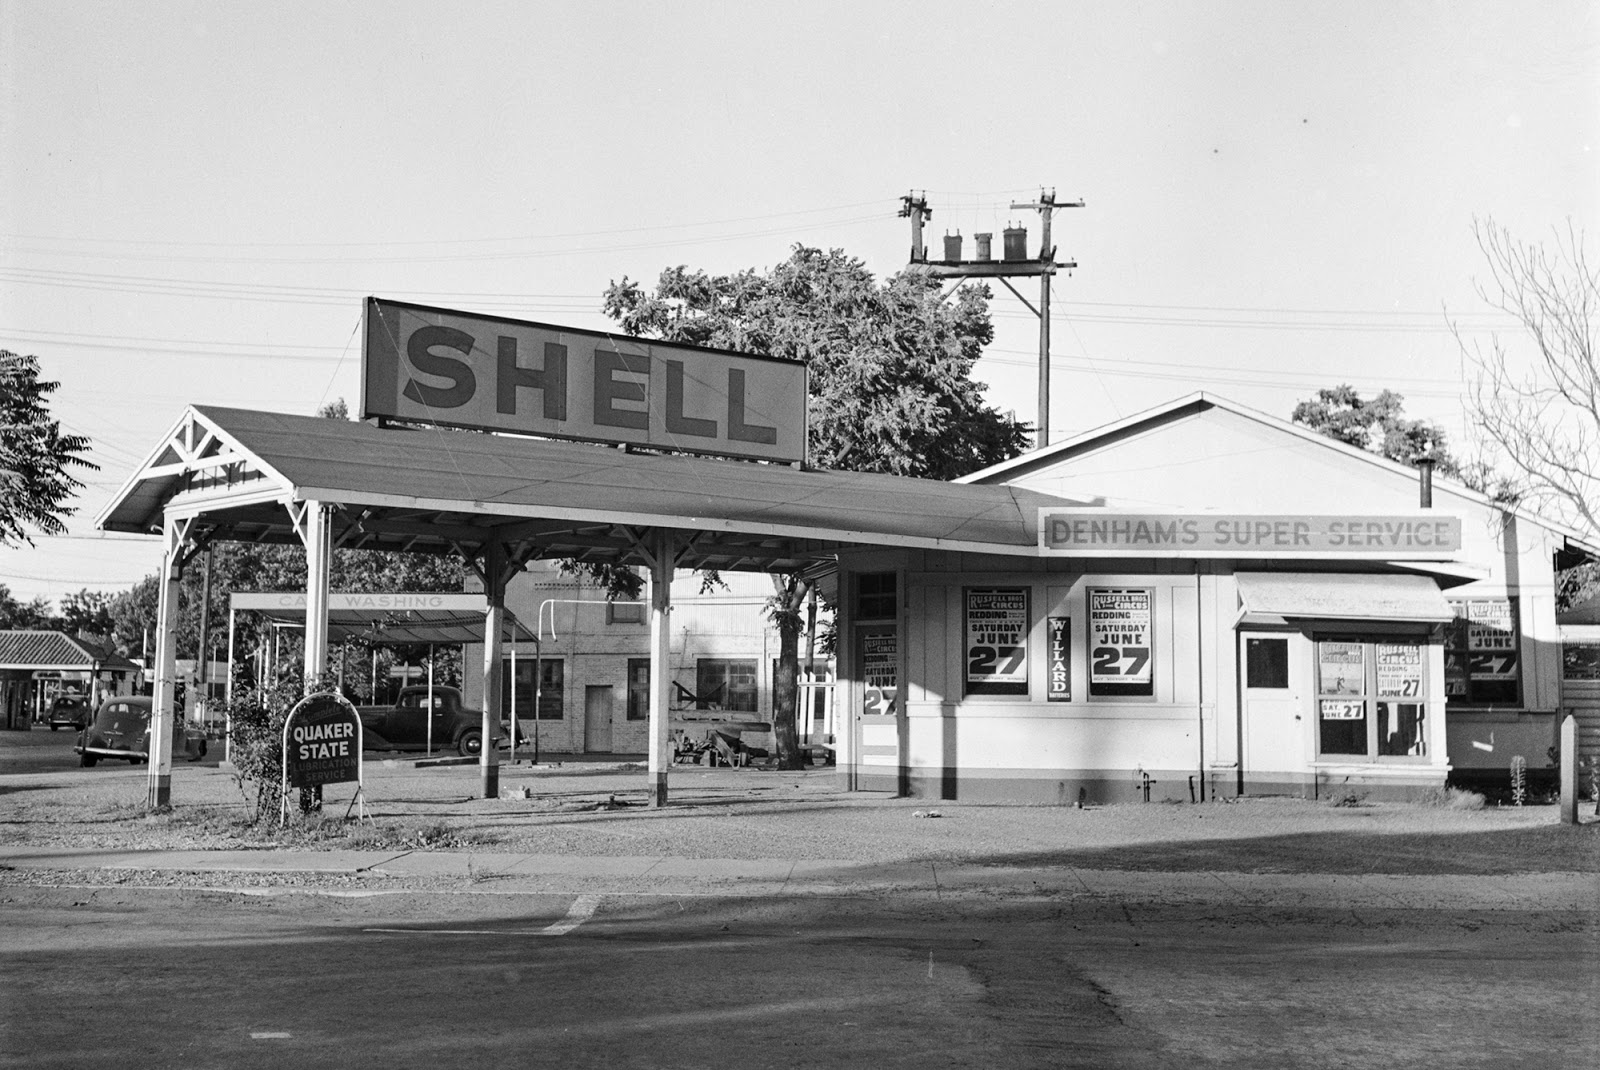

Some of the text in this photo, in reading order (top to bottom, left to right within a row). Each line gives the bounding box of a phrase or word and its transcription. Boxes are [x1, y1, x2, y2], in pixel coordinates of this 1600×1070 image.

[402, 325, 777, 445] SHELL
[1051, 519, 1450, 546] DENHAM'S SUPER SERVICE
[279, 595, 444, 608] CA WASHING
[991, 601, 1024, 609] CIRCUS
[1114, 601, 1148, 610] CIRCUS
[969, 611, 1008, 619] REDDING
[1092, 611, 1131, 620] REDDING
[971, 623, 1023, 632] SATURDAY
[1095, 624, 1146, 632] SATURDAY
[976, 633, 1019, 645] JUNE
[1100, 633, 1142, 645] JUNE
[1475, 638, 1512, 648] JUNE
[1049, 618, 1067, 692] WILLARD
[1379, 645, 1418, 655] RUSSELL
[969, 646, 1025, 675] 27
[1093, 647, 1150, 676] 27
[1379, 655, 1419, 664] CIRCUS
[1469, 653, 1517, 674] 27
[869, 676, 896, 687] JUNE
[1381, 689, 1402, 697] JUNE
[1402, 679, 1420, 697] 27
[865, 689, 897, 715] 27
[1343, 704, 1362, 718] 27
[293, 722, 354, 744] QUAKER
[299, 741, 349, 760] STATE
[293, 757, 357, 772] LUBRICATION
[305, 769, 346, 781] SERVICE
